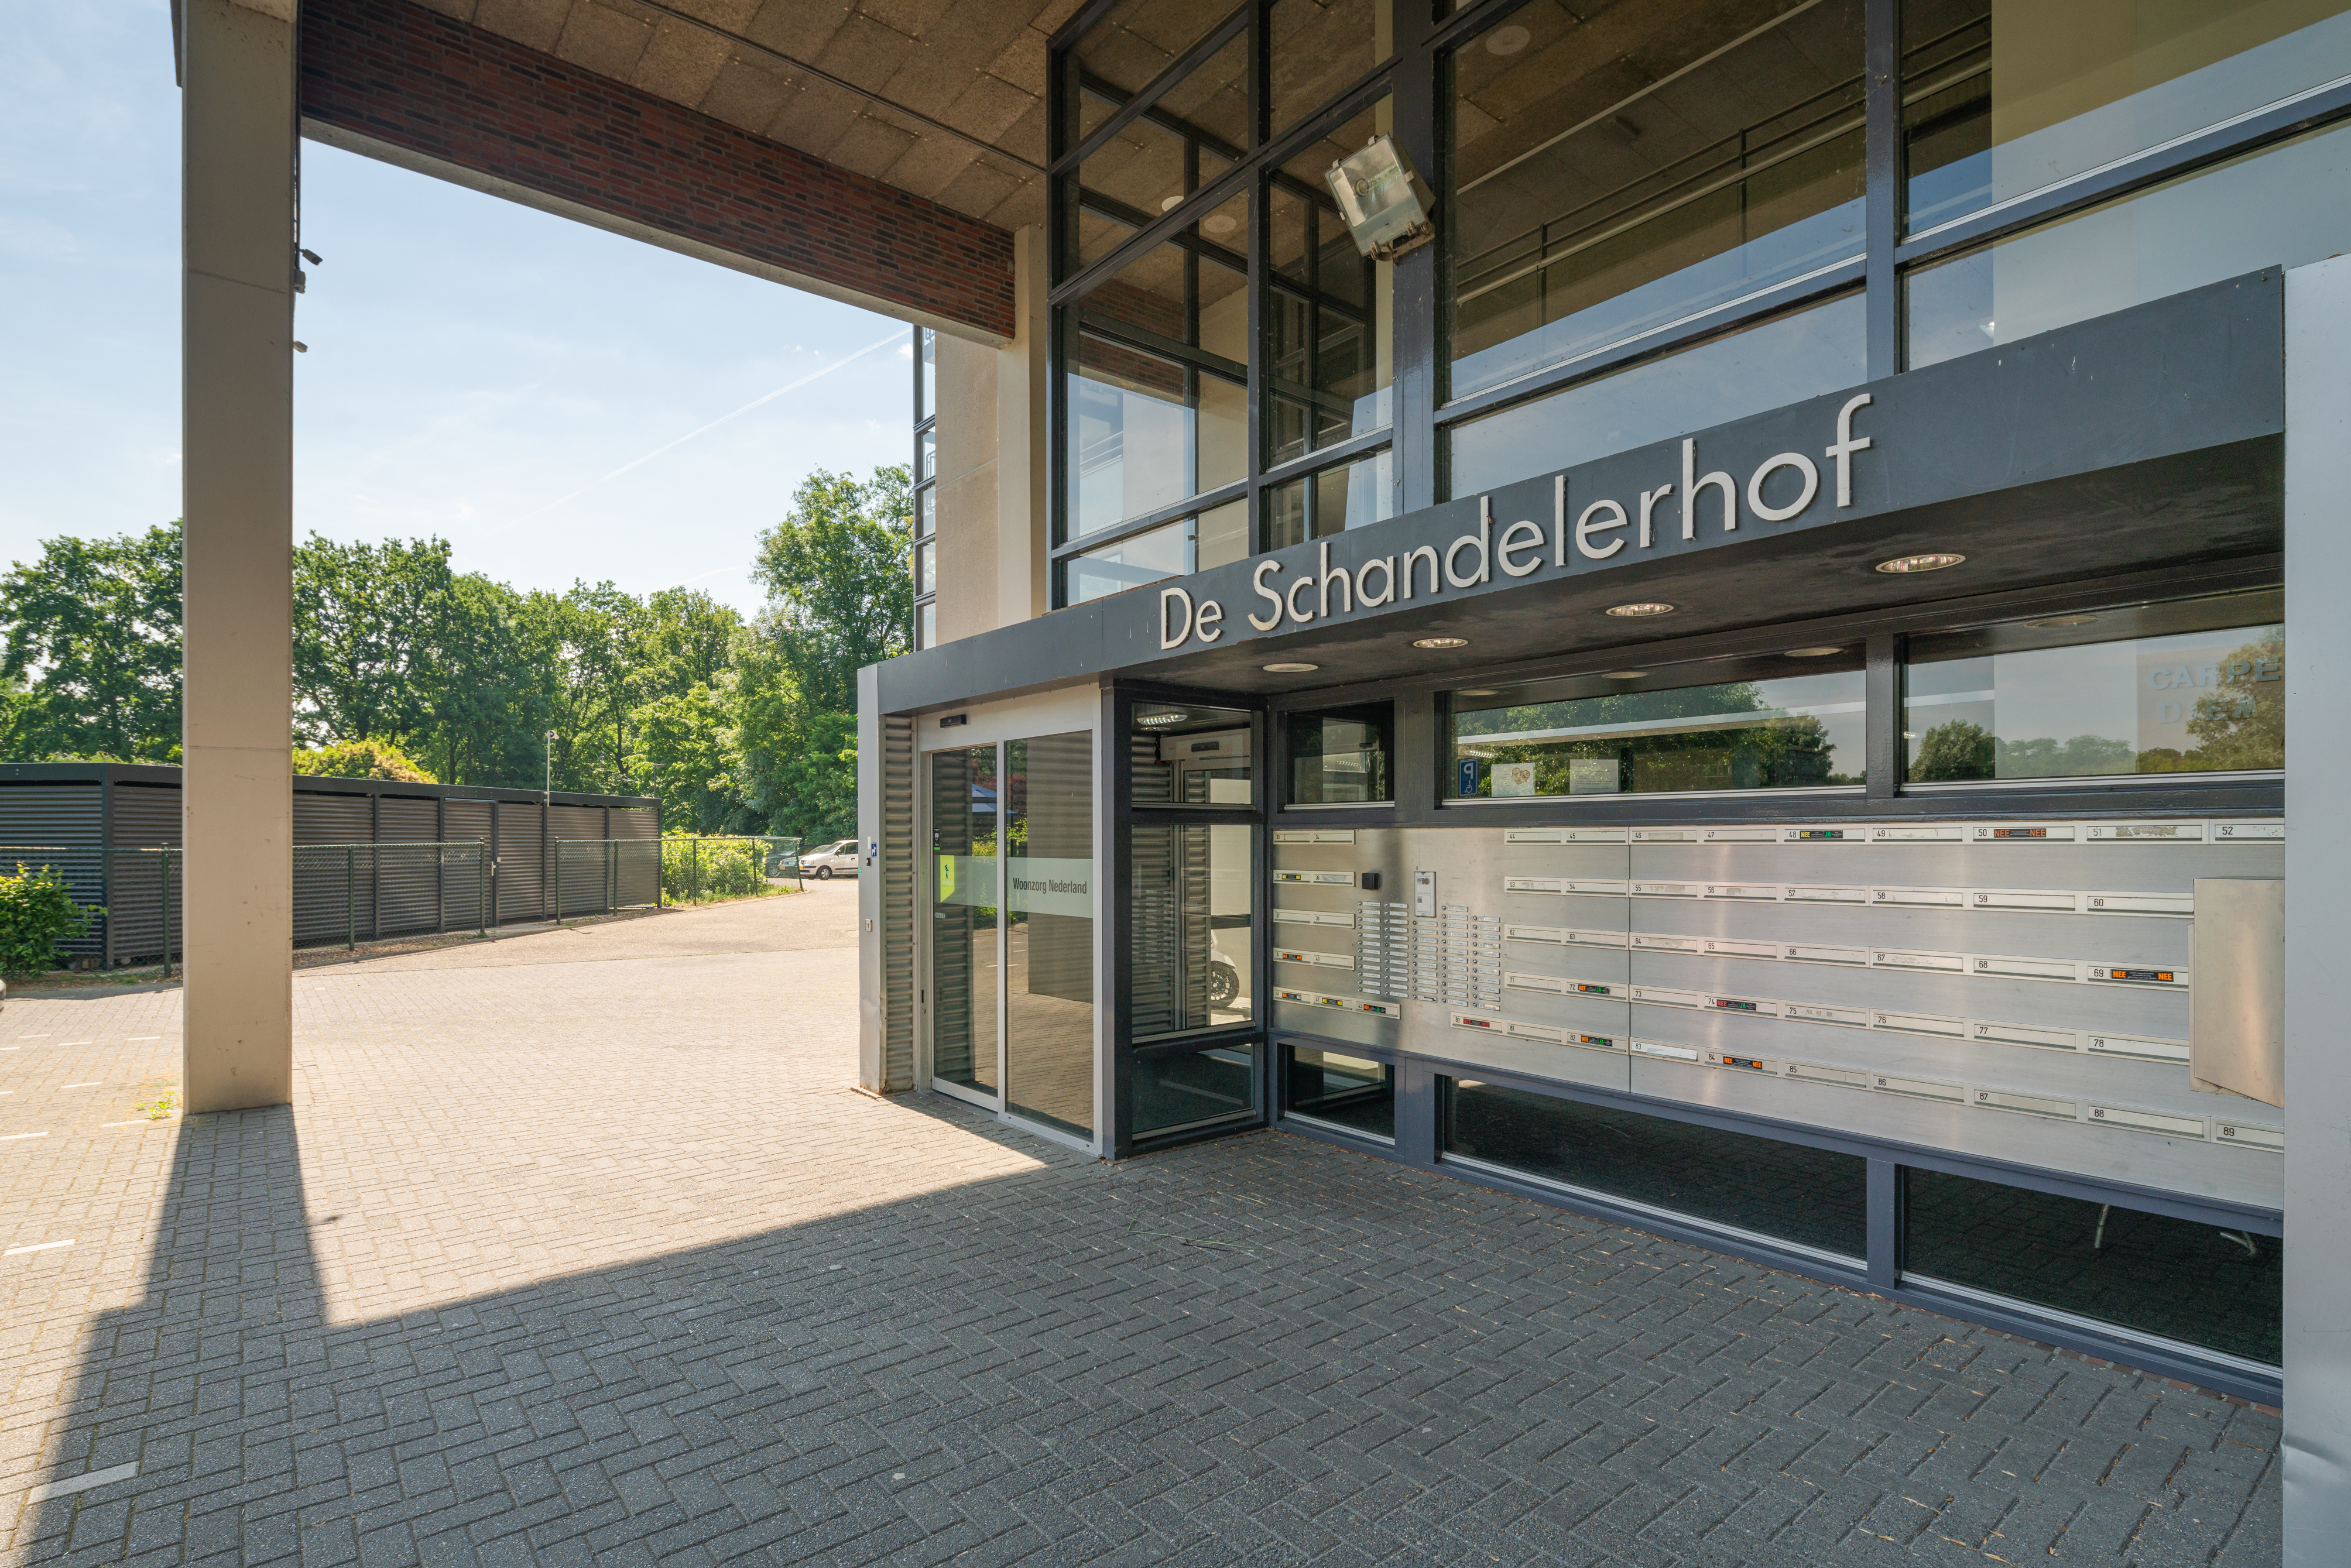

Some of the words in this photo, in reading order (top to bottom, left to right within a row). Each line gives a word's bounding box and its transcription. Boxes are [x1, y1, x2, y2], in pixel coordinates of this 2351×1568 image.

[1161, 587, 1222, 650] De
[1248, 393, 1872, 632] Schandelerhof
[2148, 657, 2280, 690] CARPE
[1877, 829, 1886, 838] 49
[1978, 829, 1987, 837] 50
[2093, 828, 2102, 836] 51
[2222, 826, 2233, 835] 52
[1013, 878, 1047, 894] Woonzorg
[1049, 879, 1087, 894] Nederland
[1979, 895, 1987, 903] 59
[2093, 898, 2104, 907] 60
[1979, 960, 1988, 969] 68
[2094, 969, 2104, 977] 69
[1790, 1007, 1797, 1015] 75
[1878, 1015, 1886, 1024] 76
[1979, 1026, 1989, 1035] 77
[2094, 1038, 2104, 1048] 78
[1790, 1065, 1797, 1073] 85
[1878, 1078, 1886, 1086] 86
[1979, 1092, 1989, 1100] 87
[2094, 1109, 2104, 1118] 88
[2223, 1127, 2235, 1137] 89
